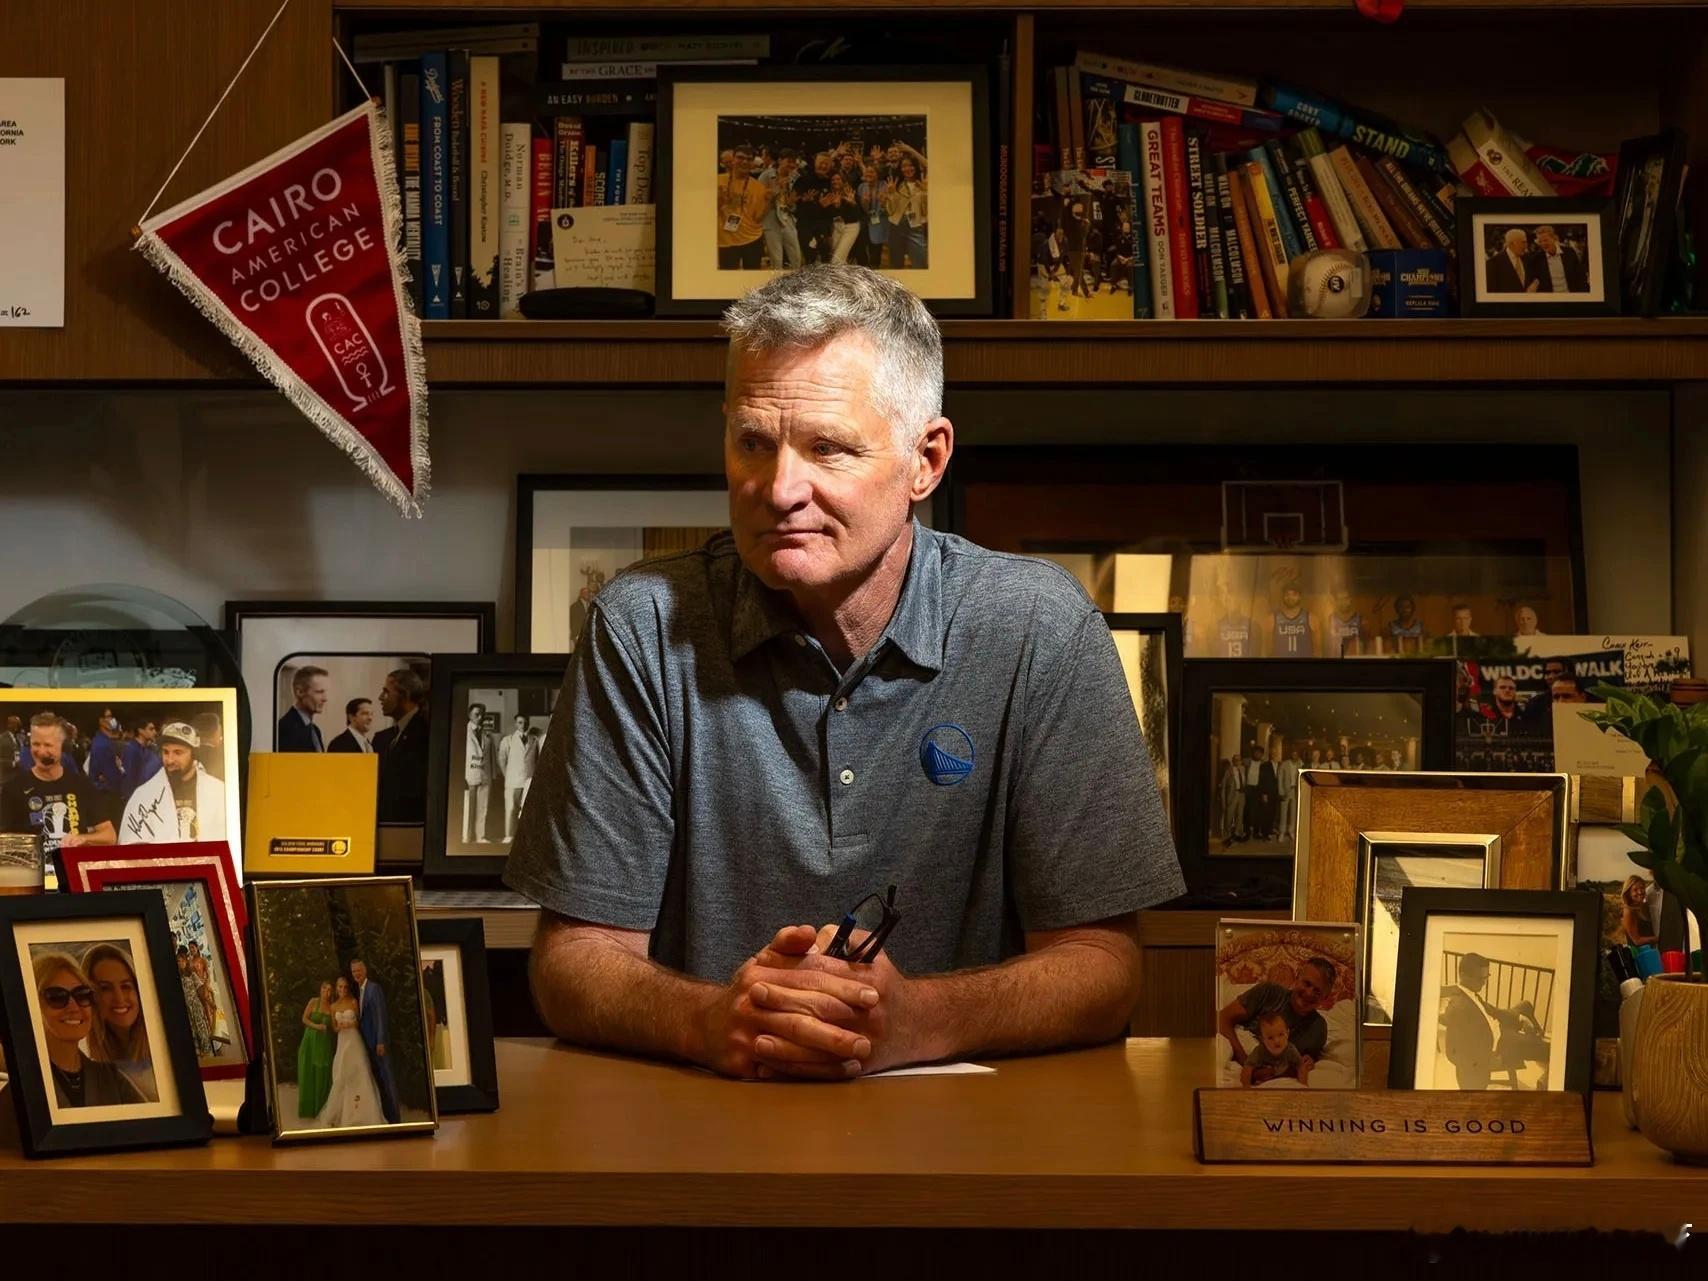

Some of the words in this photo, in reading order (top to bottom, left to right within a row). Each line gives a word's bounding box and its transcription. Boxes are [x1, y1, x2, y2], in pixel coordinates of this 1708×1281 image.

[598, 65, 643, 76] GRACE
[450, 79, 464, 128] Wooden
[547, 94, 559, 105] AN
[561, 94, 583, 104] EASY
[433, 116, 442, 143] FROM
[1352, 124, 1410, 160] STAND
[433, 145, 442, 177] COAST
[503, 133, 513, 176] Doidge,
[516, 144, 526, 190] Norman
[569, 139, 579, 186] Killers
[636, 147, 649, 173] Top
[1147, 130, 1161, 181] GREAT
[1187, 137, 1202, 189] STREET
[433, 178, 442, 193] TO
[212, 167, 343, 255] CAIRO
[433, 194, 442, 225] COAST
[1151, 185, 1165, 237] TEAMS
[1192, 192, 1207, 249] SOLDIER
[1286, 186, 1307, 222] PERFECT
[231, 203, 361, 285] AMERICAN
[239, 227, 374, 313] COLLEGE
[503, 258, 512, 302] Healing
[334, 332, 363, 357] CAC
[1279, 625, 1305, 635] USA
[1288, 634, 1297, 652] 11
[1480, 664, 1544, 681] WILDC
[1574, 660, 1624, 677] WALK
[1263, 1119, 1388, 1134] WINNING
[1404, 1119, 1428, 1134] IS
[1444, 1119, 1527, 1135] GOOD
